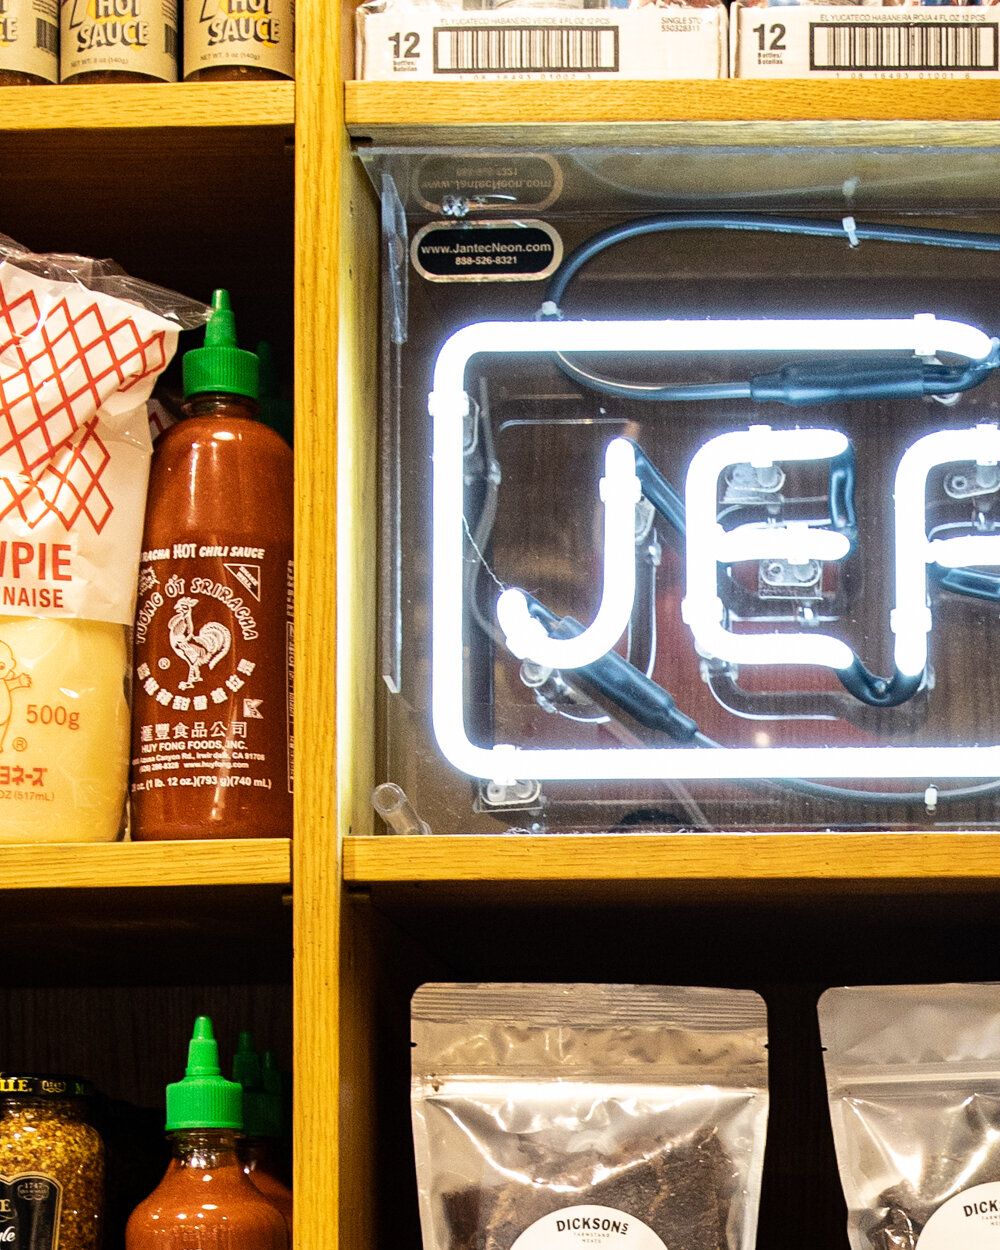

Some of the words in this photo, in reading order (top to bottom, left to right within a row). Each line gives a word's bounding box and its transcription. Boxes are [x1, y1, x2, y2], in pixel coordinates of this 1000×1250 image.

[208, 18, 280, 46] SAUCE
[661, 17, 686, 25] SINGLE
[77, 18, 150, 51] SAUCE
[388, 32, 420, 58] 12
[753, 24, 786, 50] 12
[421, 243, 552, 255] www.JantecNeon.com
[173, 543, 197, 559] HOT
[199, 546, 228, 558] CHILI
[230, 546, 265, 559] SAUCE
[3, 586, 64, 608] NAISE
[190, 577, 259, 640] SRIRACHA
[26, 704, 80, 730] 500g
[141, 743, 157, 753] HUY
[159, 742, 186, 751] FONG
[187, 740, 225, 750] FOODS,
[154, 778, 165, 787] lb.
[167, 777, 178, 786] 12
[14, 791, 55, 801] (517mL)
